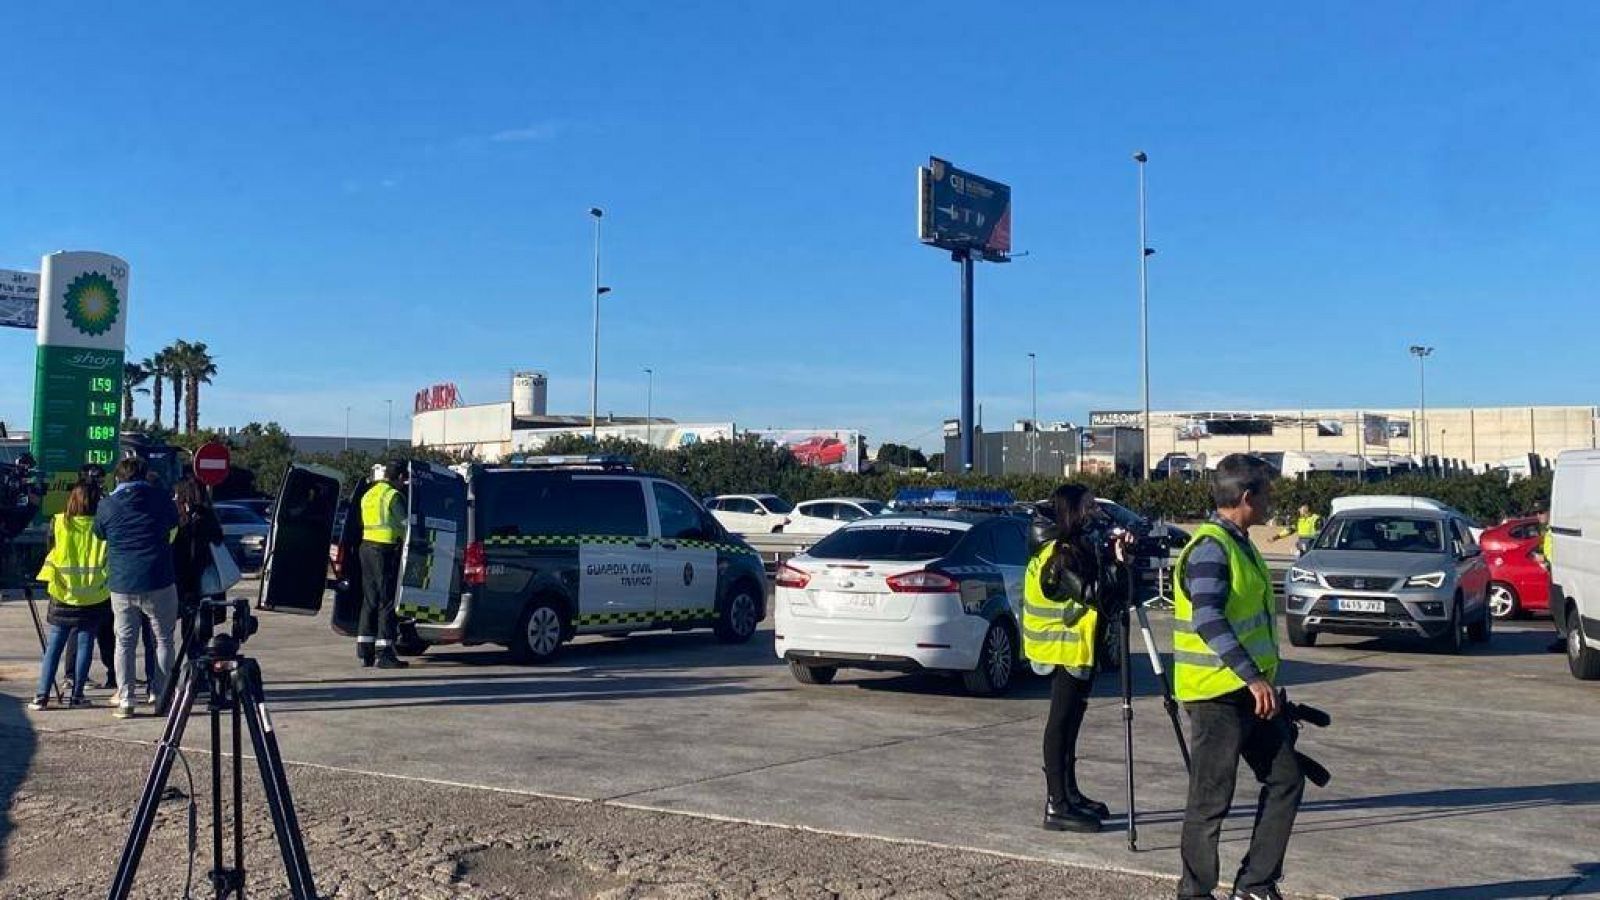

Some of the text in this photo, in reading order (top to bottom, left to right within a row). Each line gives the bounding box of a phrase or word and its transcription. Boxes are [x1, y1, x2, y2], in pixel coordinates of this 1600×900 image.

[73, 352, 116, 368] shop
[587, 563, 653, 575] GUARDIA CIVIL
